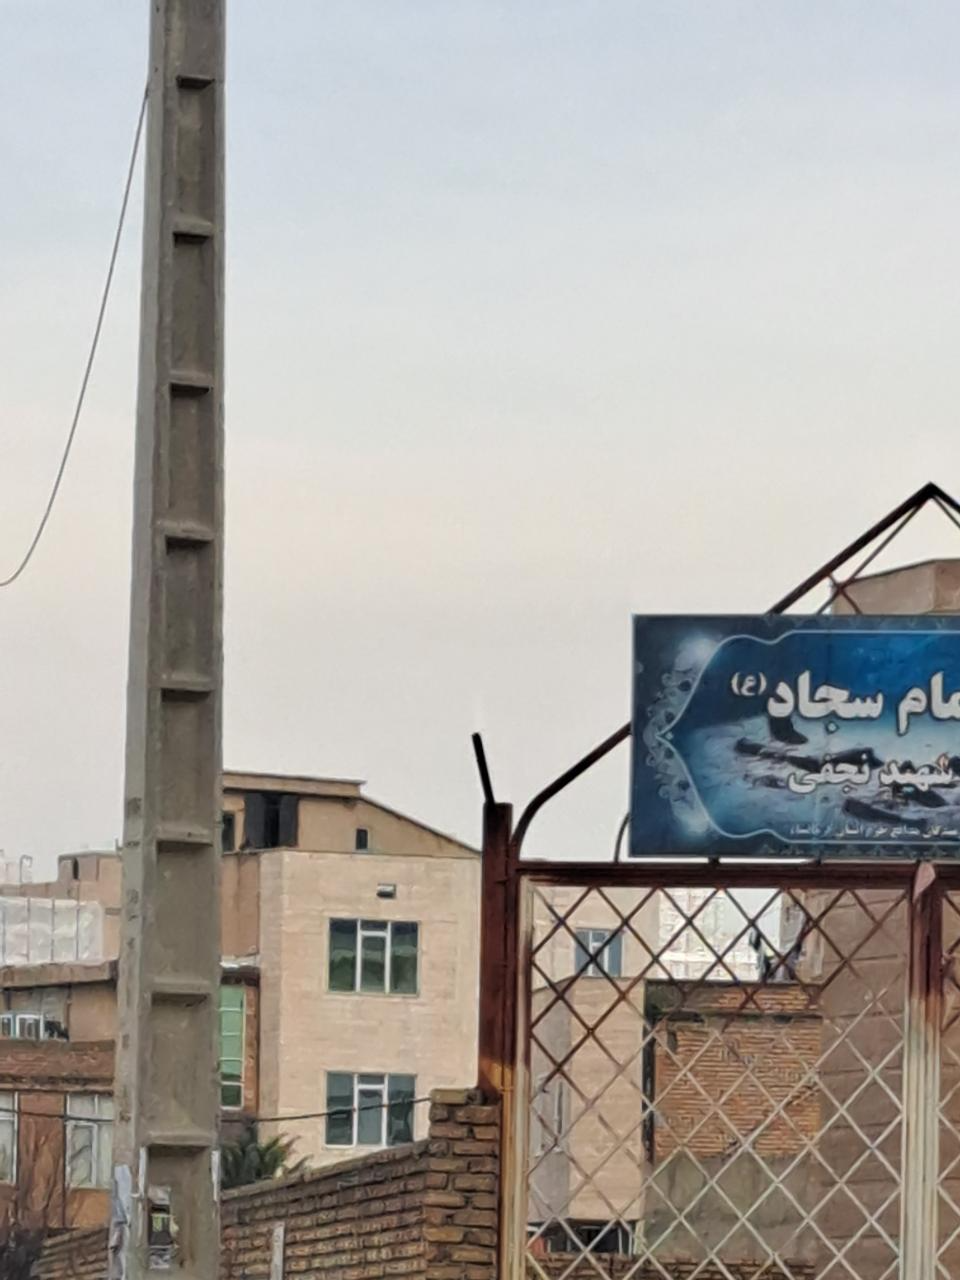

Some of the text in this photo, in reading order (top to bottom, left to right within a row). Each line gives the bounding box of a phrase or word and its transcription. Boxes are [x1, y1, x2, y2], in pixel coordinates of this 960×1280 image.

[730, 670, 767, 698] (ع)
[766, 670, 884, 733] سجاد
[787, 753, 871, 796] نجفی
[880, 751, 953, 798] شهید
